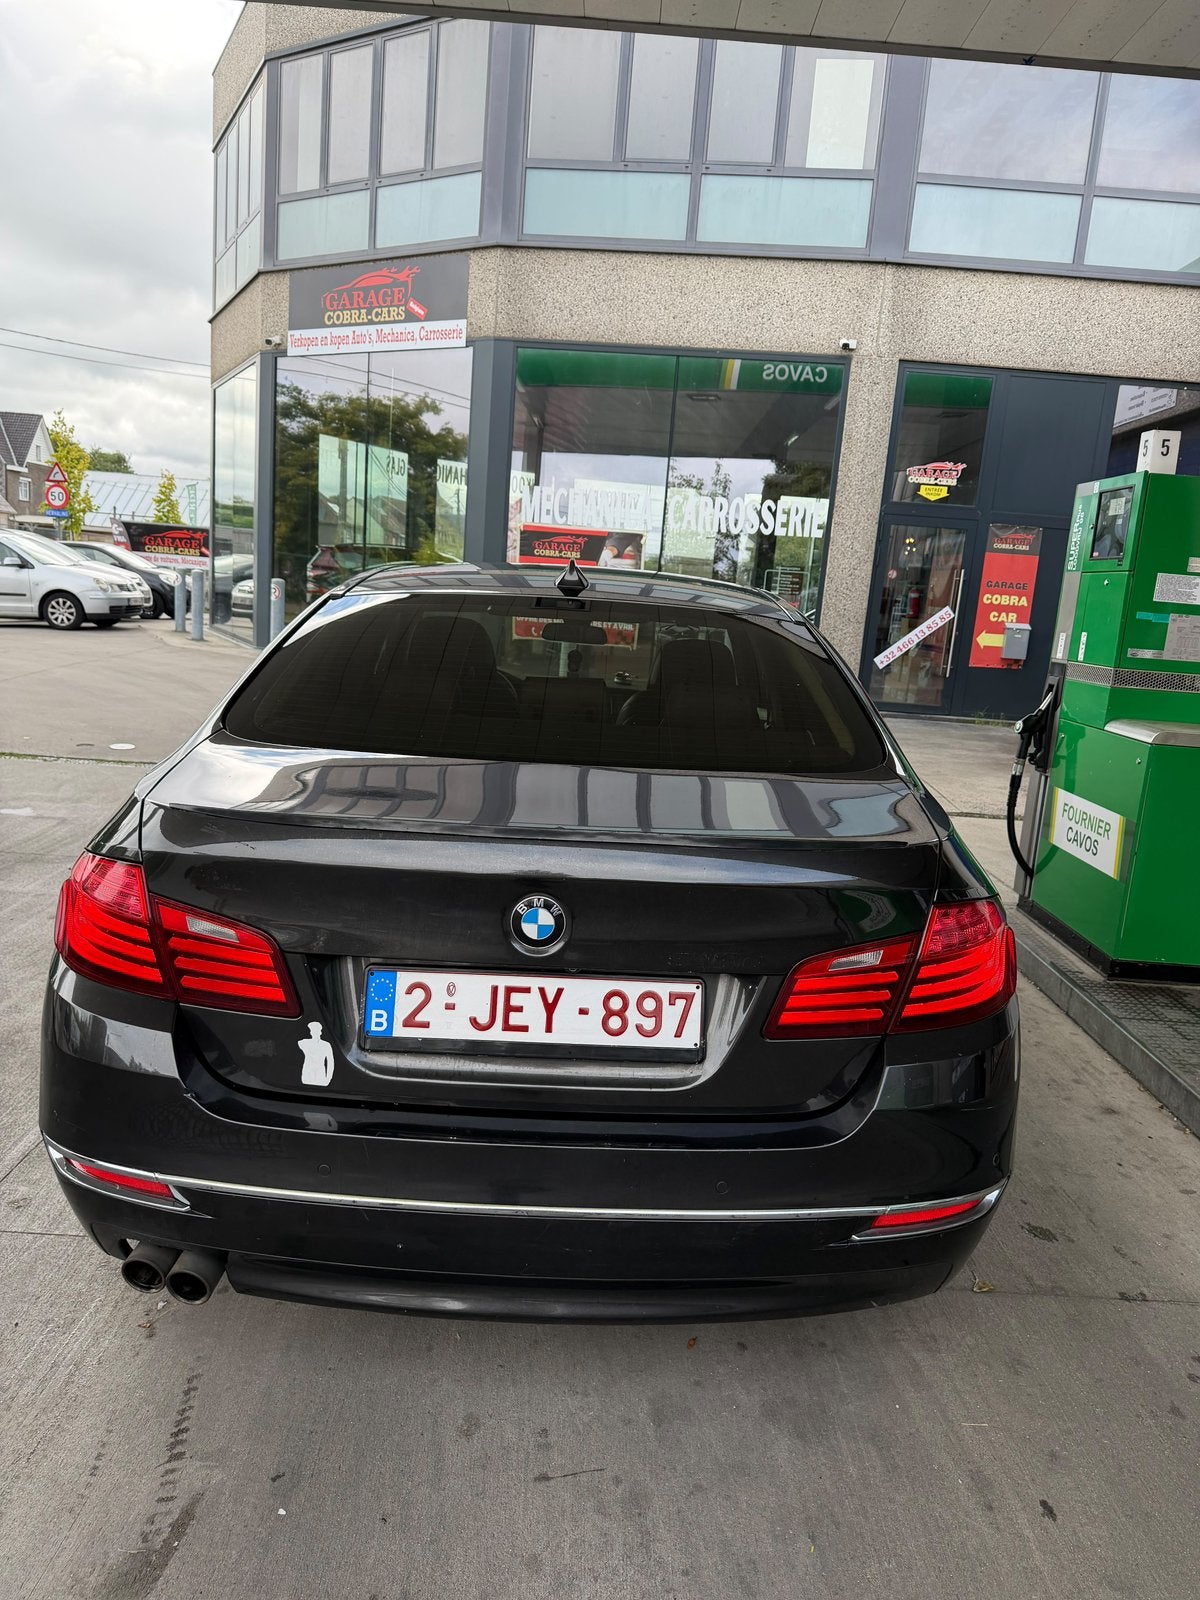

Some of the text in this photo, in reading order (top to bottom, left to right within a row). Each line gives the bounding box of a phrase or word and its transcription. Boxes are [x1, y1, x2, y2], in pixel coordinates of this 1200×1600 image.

[324, 288, 406, 311] GARAGE
[324, 306, 406, 326] COBRA-CARS
[290, 324, 463, 351] Verkopen en kopen Auto's, Mechanica, Carrosserie
[1143, 440, 1149, 457] 5
[1161, 439, 1170, 456] 5
[908, 468, 958, 479] GARAGE
[50, 491, 65, 502] 50
[668, 494, 824, 538] CARROSSERIE
[145, 535, 200, 549] GARAGE
[534, 541, 581, 553] GARAGE
[994, 537, 1031, 546] GARAGE
[145, 545, 201, 556] COBRA-CARS
[534, 549, 581, 558] COBRA-CARS
[986, 581, 1028, 590] GARAGE
[983, 594, 1028, 606] COBRA
[989, 611, 1017, 623] CAR
[879, 610, 952, 666] +32 466 13 85 85
[1062, 802, 1111, 840] FOURNIER
[1066, 826, 1099, 856] CAVOS
[516, 898, 562, 917] BMW
[370, 1009, 388, 1031] B
